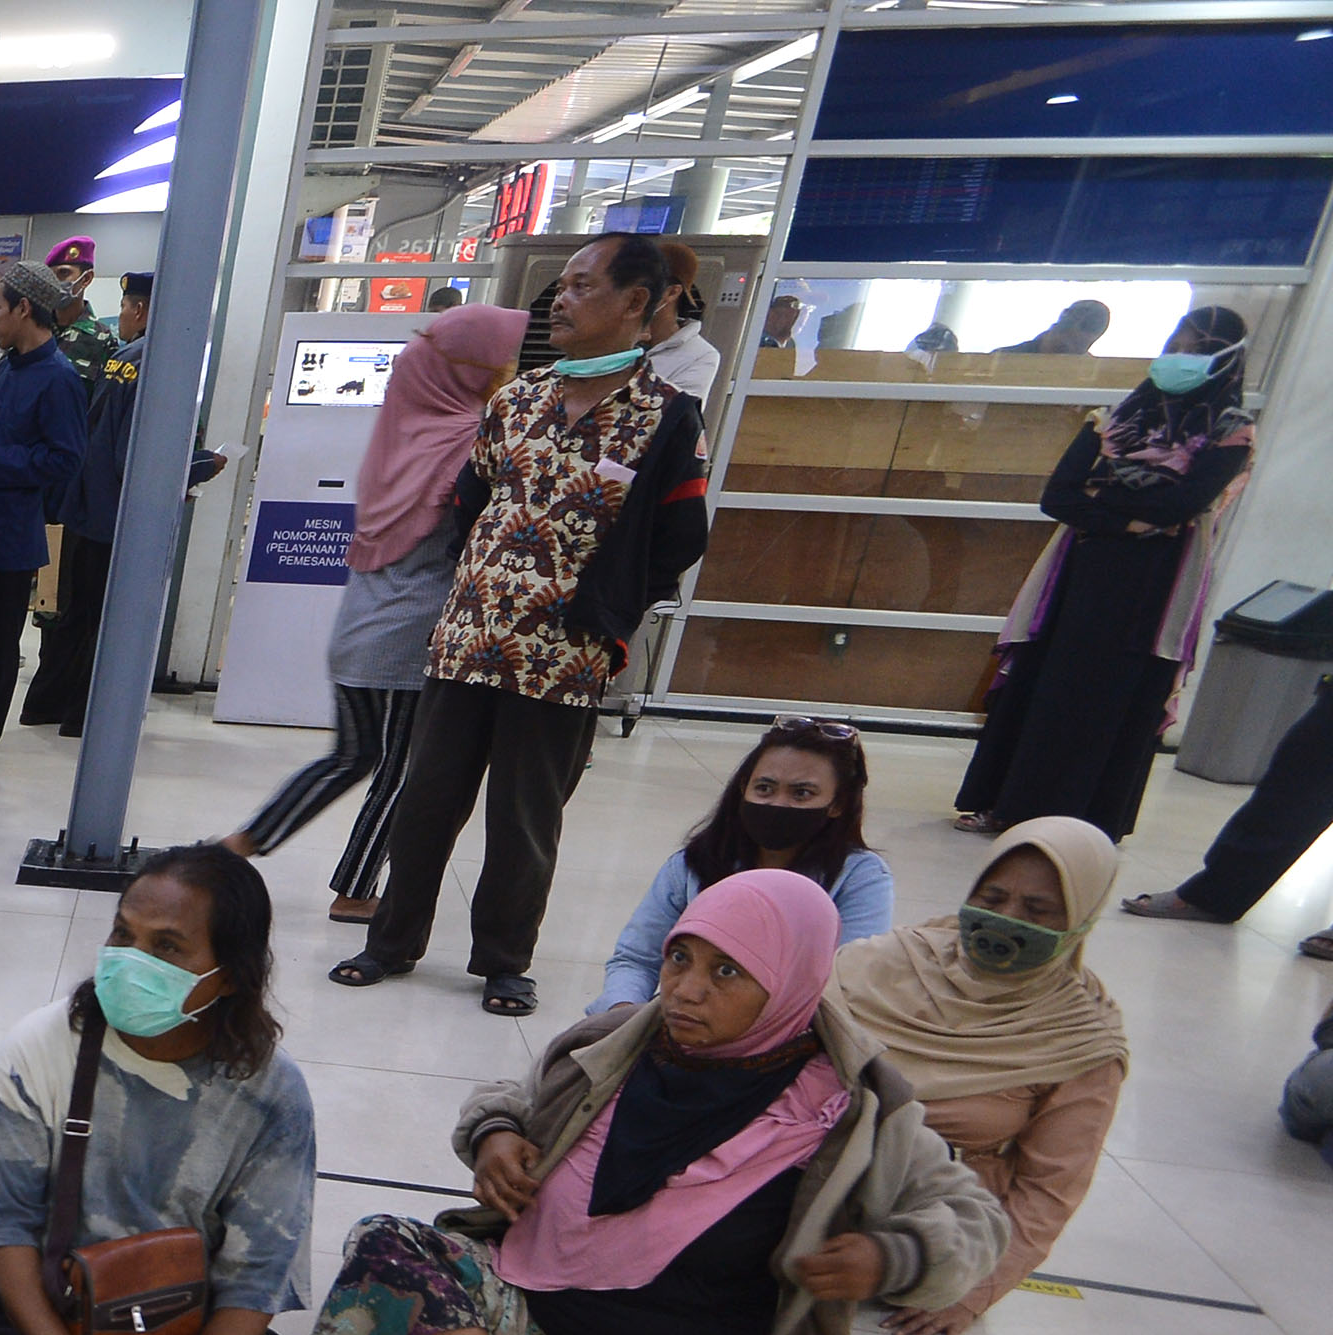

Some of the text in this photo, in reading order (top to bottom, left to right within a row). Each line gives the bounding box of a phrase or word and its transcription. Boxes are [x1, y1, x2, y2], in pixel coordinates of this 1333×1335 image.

[304, 519, 342, 529] MESIN
[273, 530, 355, 542] NOMOR ANTRI
[266, 542, 336, 554] (PELAYANAN
